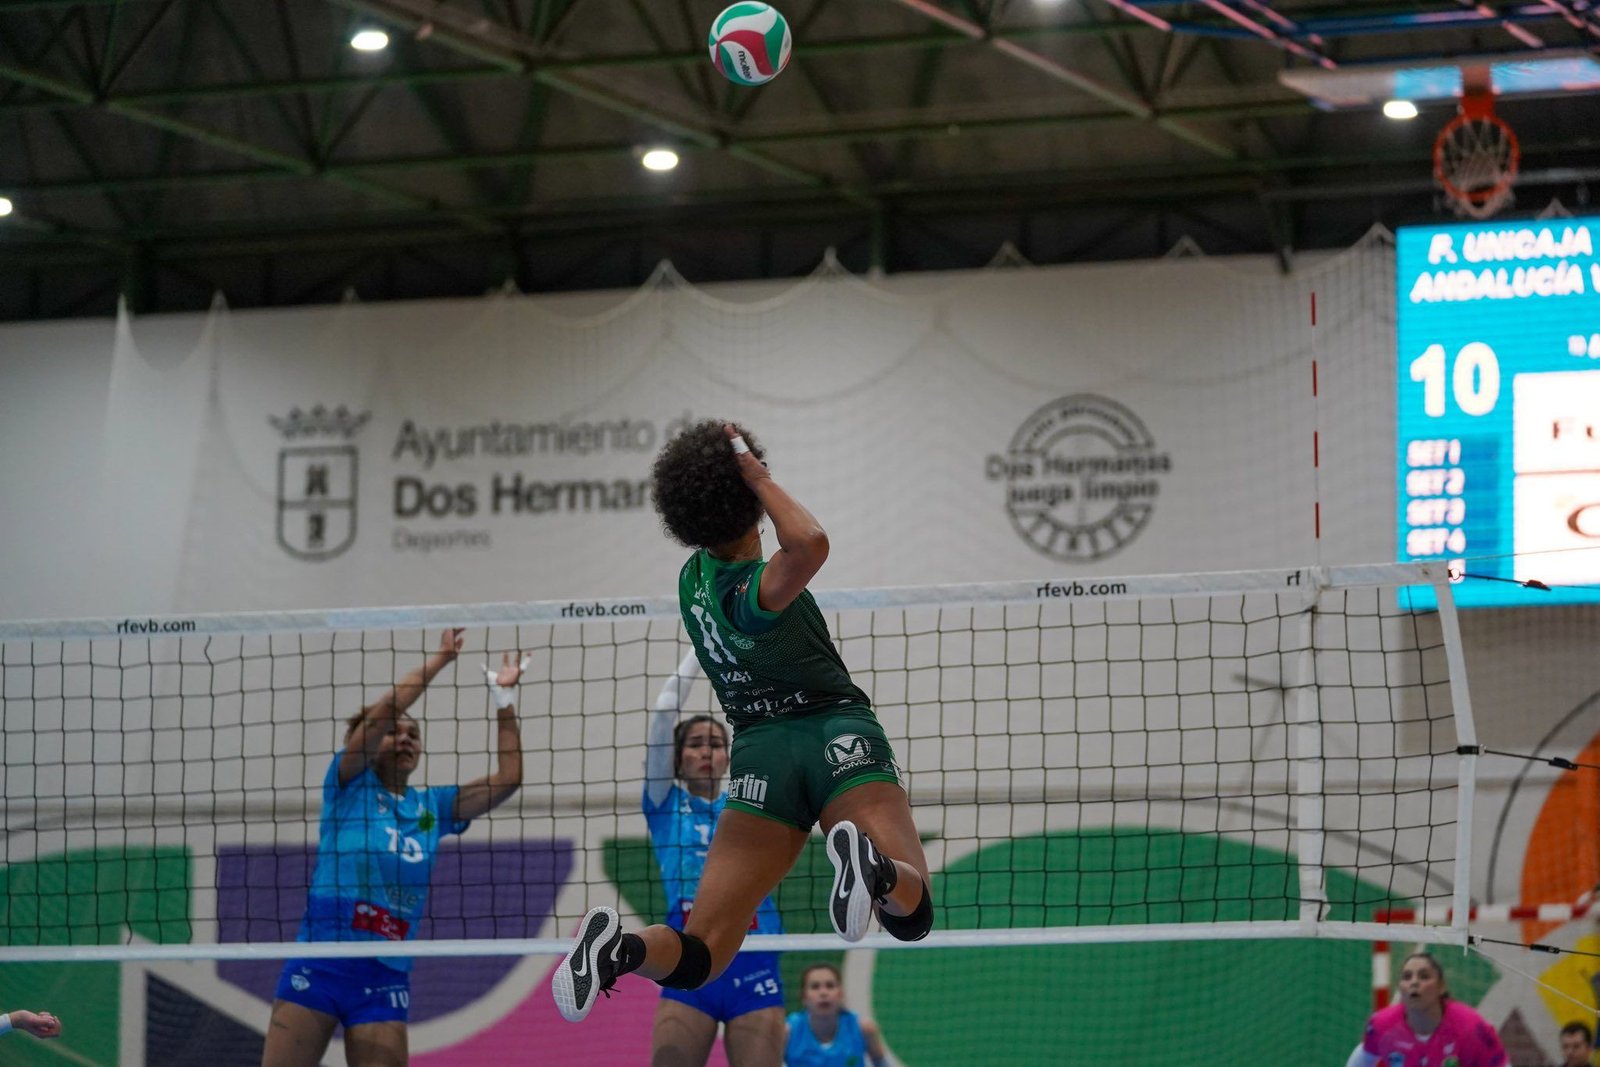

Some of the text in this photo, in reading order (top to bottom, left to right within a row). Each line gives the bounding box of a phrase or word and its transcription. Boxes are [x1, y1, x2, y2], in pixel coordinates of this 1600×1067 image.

[1463, 225, 1592, 263] UNICAJA
[1410, 259, 1585, 303] ANDALUCÍA
[1411, 342, 1500, 417] 10
[393, 417, 656, 467] Ayuntamiento
[985, 452, 1171, 481] Dos Hermanas
[1446, 467, 1465, 495] 2
[394, 472, 652, 518] Dos Herman
[1010, 477, 1159, 507] juega limpio
[393, 527, 491, 552] Deportes
[1037, 581, 1127, 598] rfevb.com
[1287, 570, 1301, 586] rf
[561, 602, 646, 618] rfevb.com
[117, 619, 196, 634] rfevb.com
[690, 604, 737, 664] 11
[727, 774, 769, 803] erlin
[384, 826, 424, 864] 10
[390, 990, 409, 1009] 10
